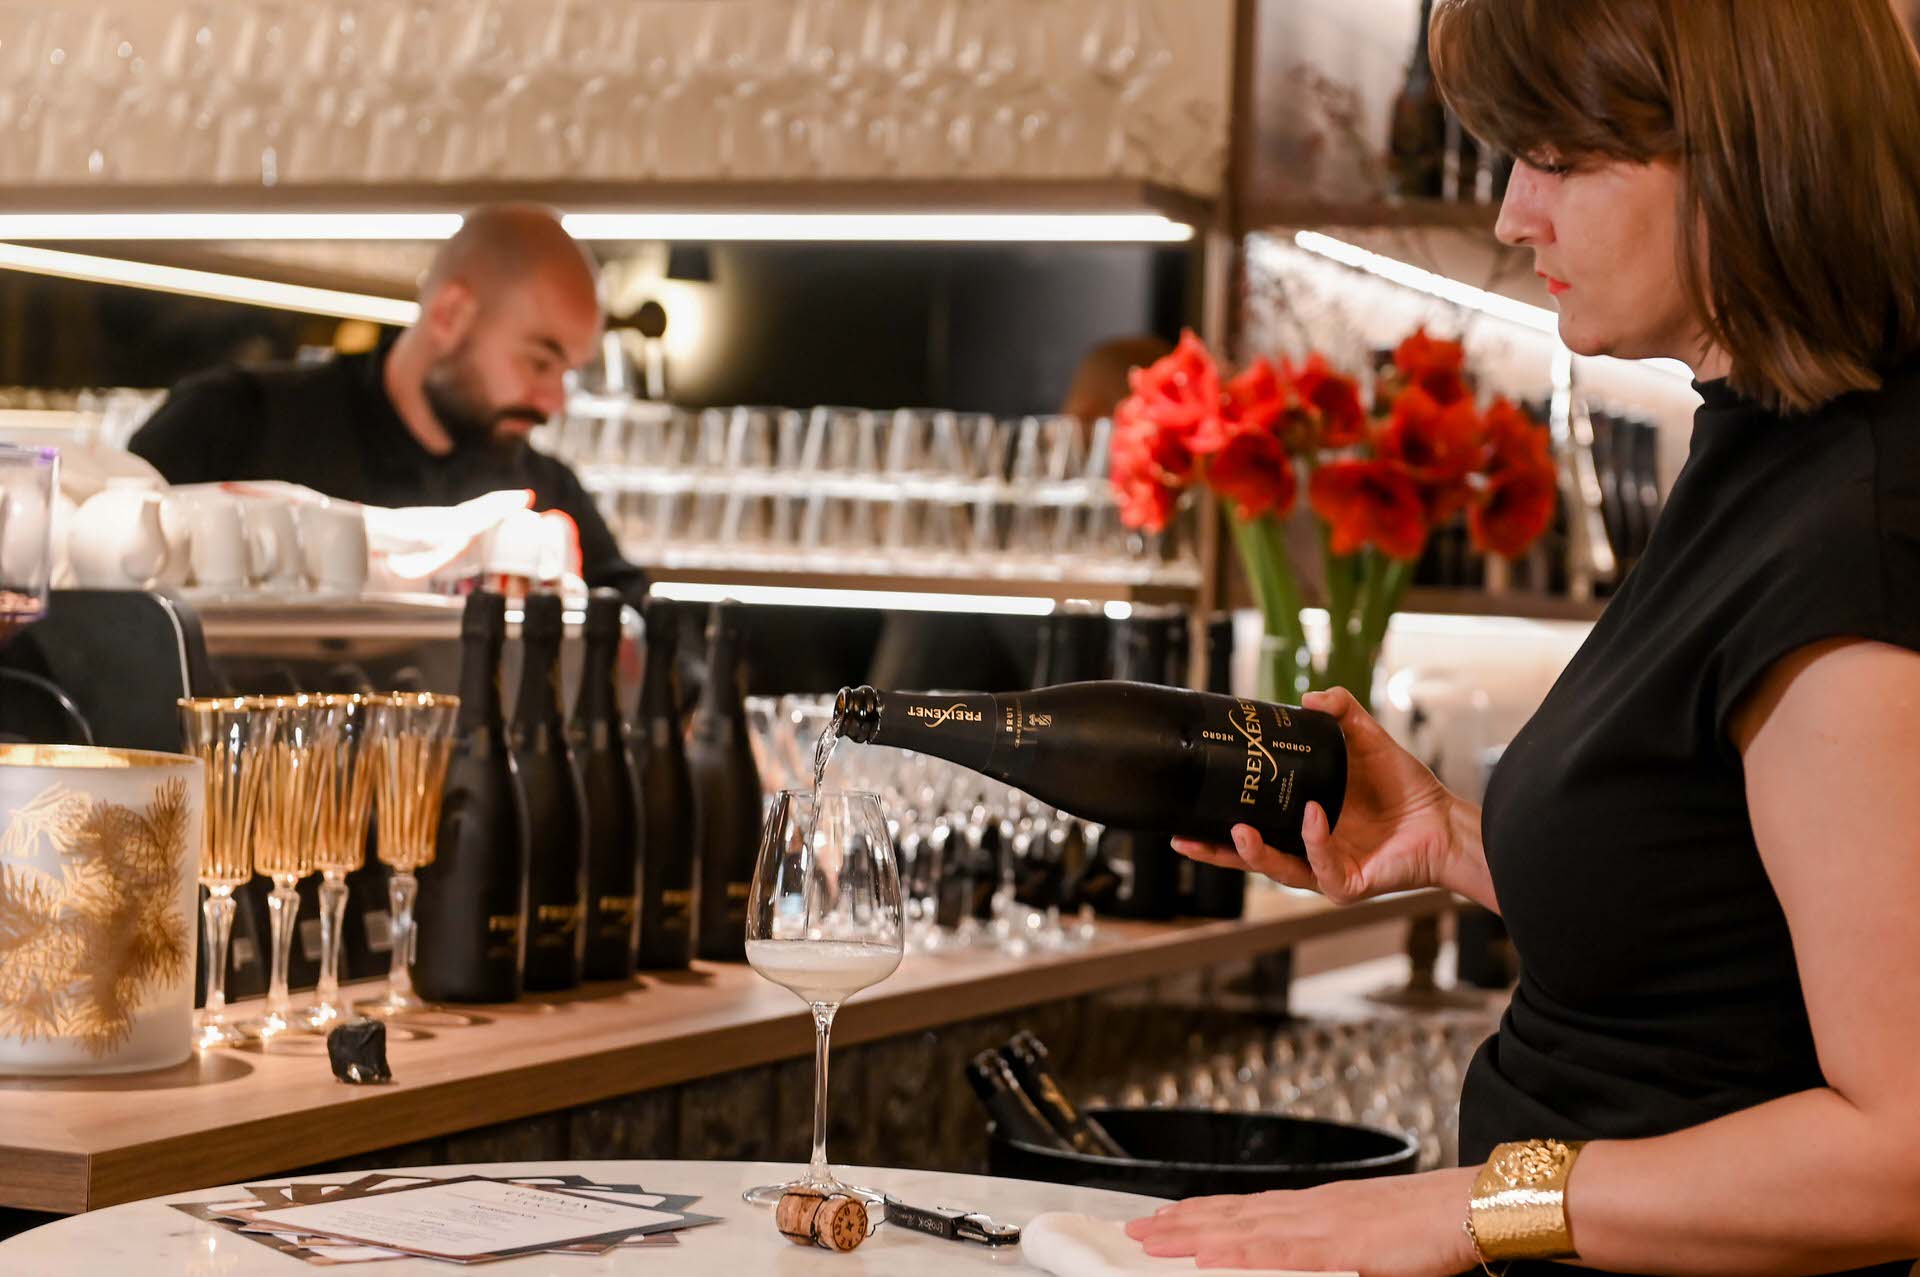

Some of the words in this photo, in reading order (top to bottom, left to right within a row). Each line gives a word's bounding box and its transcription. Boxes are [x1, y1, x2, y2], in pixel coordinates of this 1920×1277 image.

[907, 703, 982, 728] FREIXENET
[1005, 706, 1014, 733] BRUT
[1202, 730, 1234, 742] NEGRO
[1272, 740, 1311, 753] CORDON
